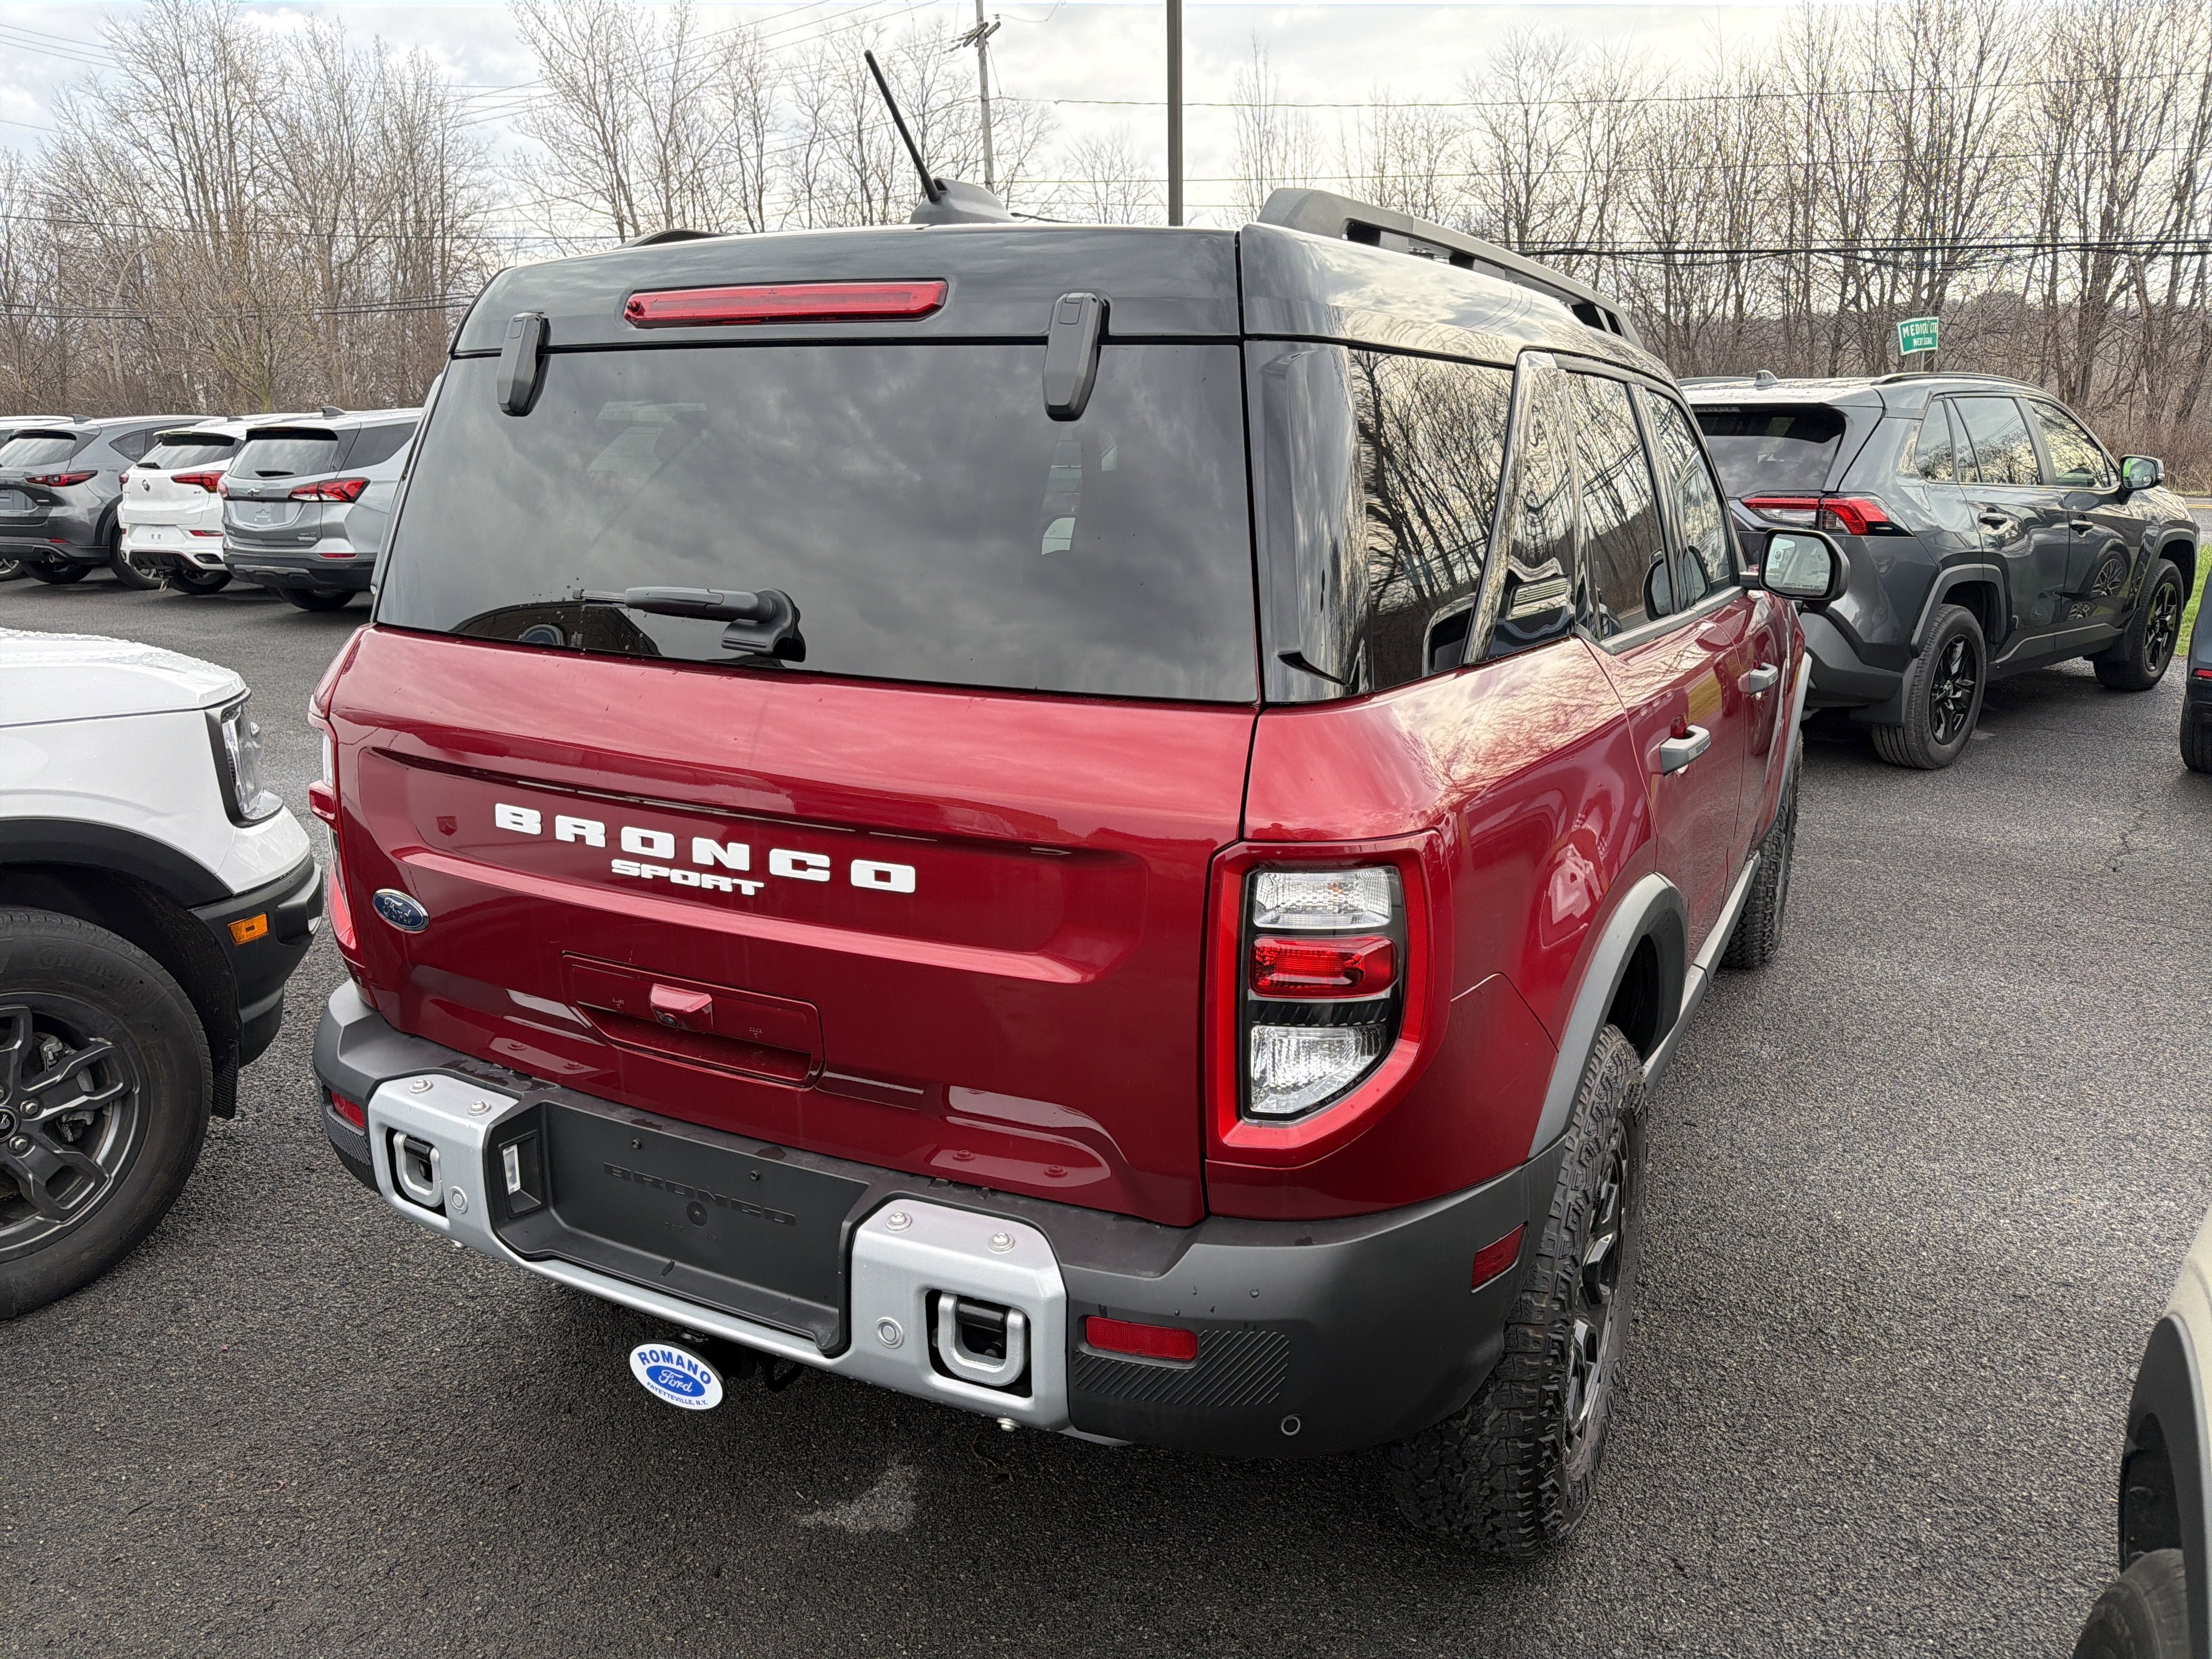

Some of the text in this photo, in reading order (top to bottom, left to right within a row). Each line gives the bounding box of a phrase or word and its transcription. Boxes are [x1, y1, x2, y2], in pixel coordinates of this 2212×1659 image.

[495, 803, 916, 893] BRONCO
[611, 859, 764, 896] SPORT
[382, 897, 412, 924] Ford
[602, 1161, 797, 1227] BRONCO
[636, 1349, 712, 1385] ROMANO
[658, 1369, 693, 1393] Ford
[646, 1381, 696, 1406] FAYETTEVILLE,
